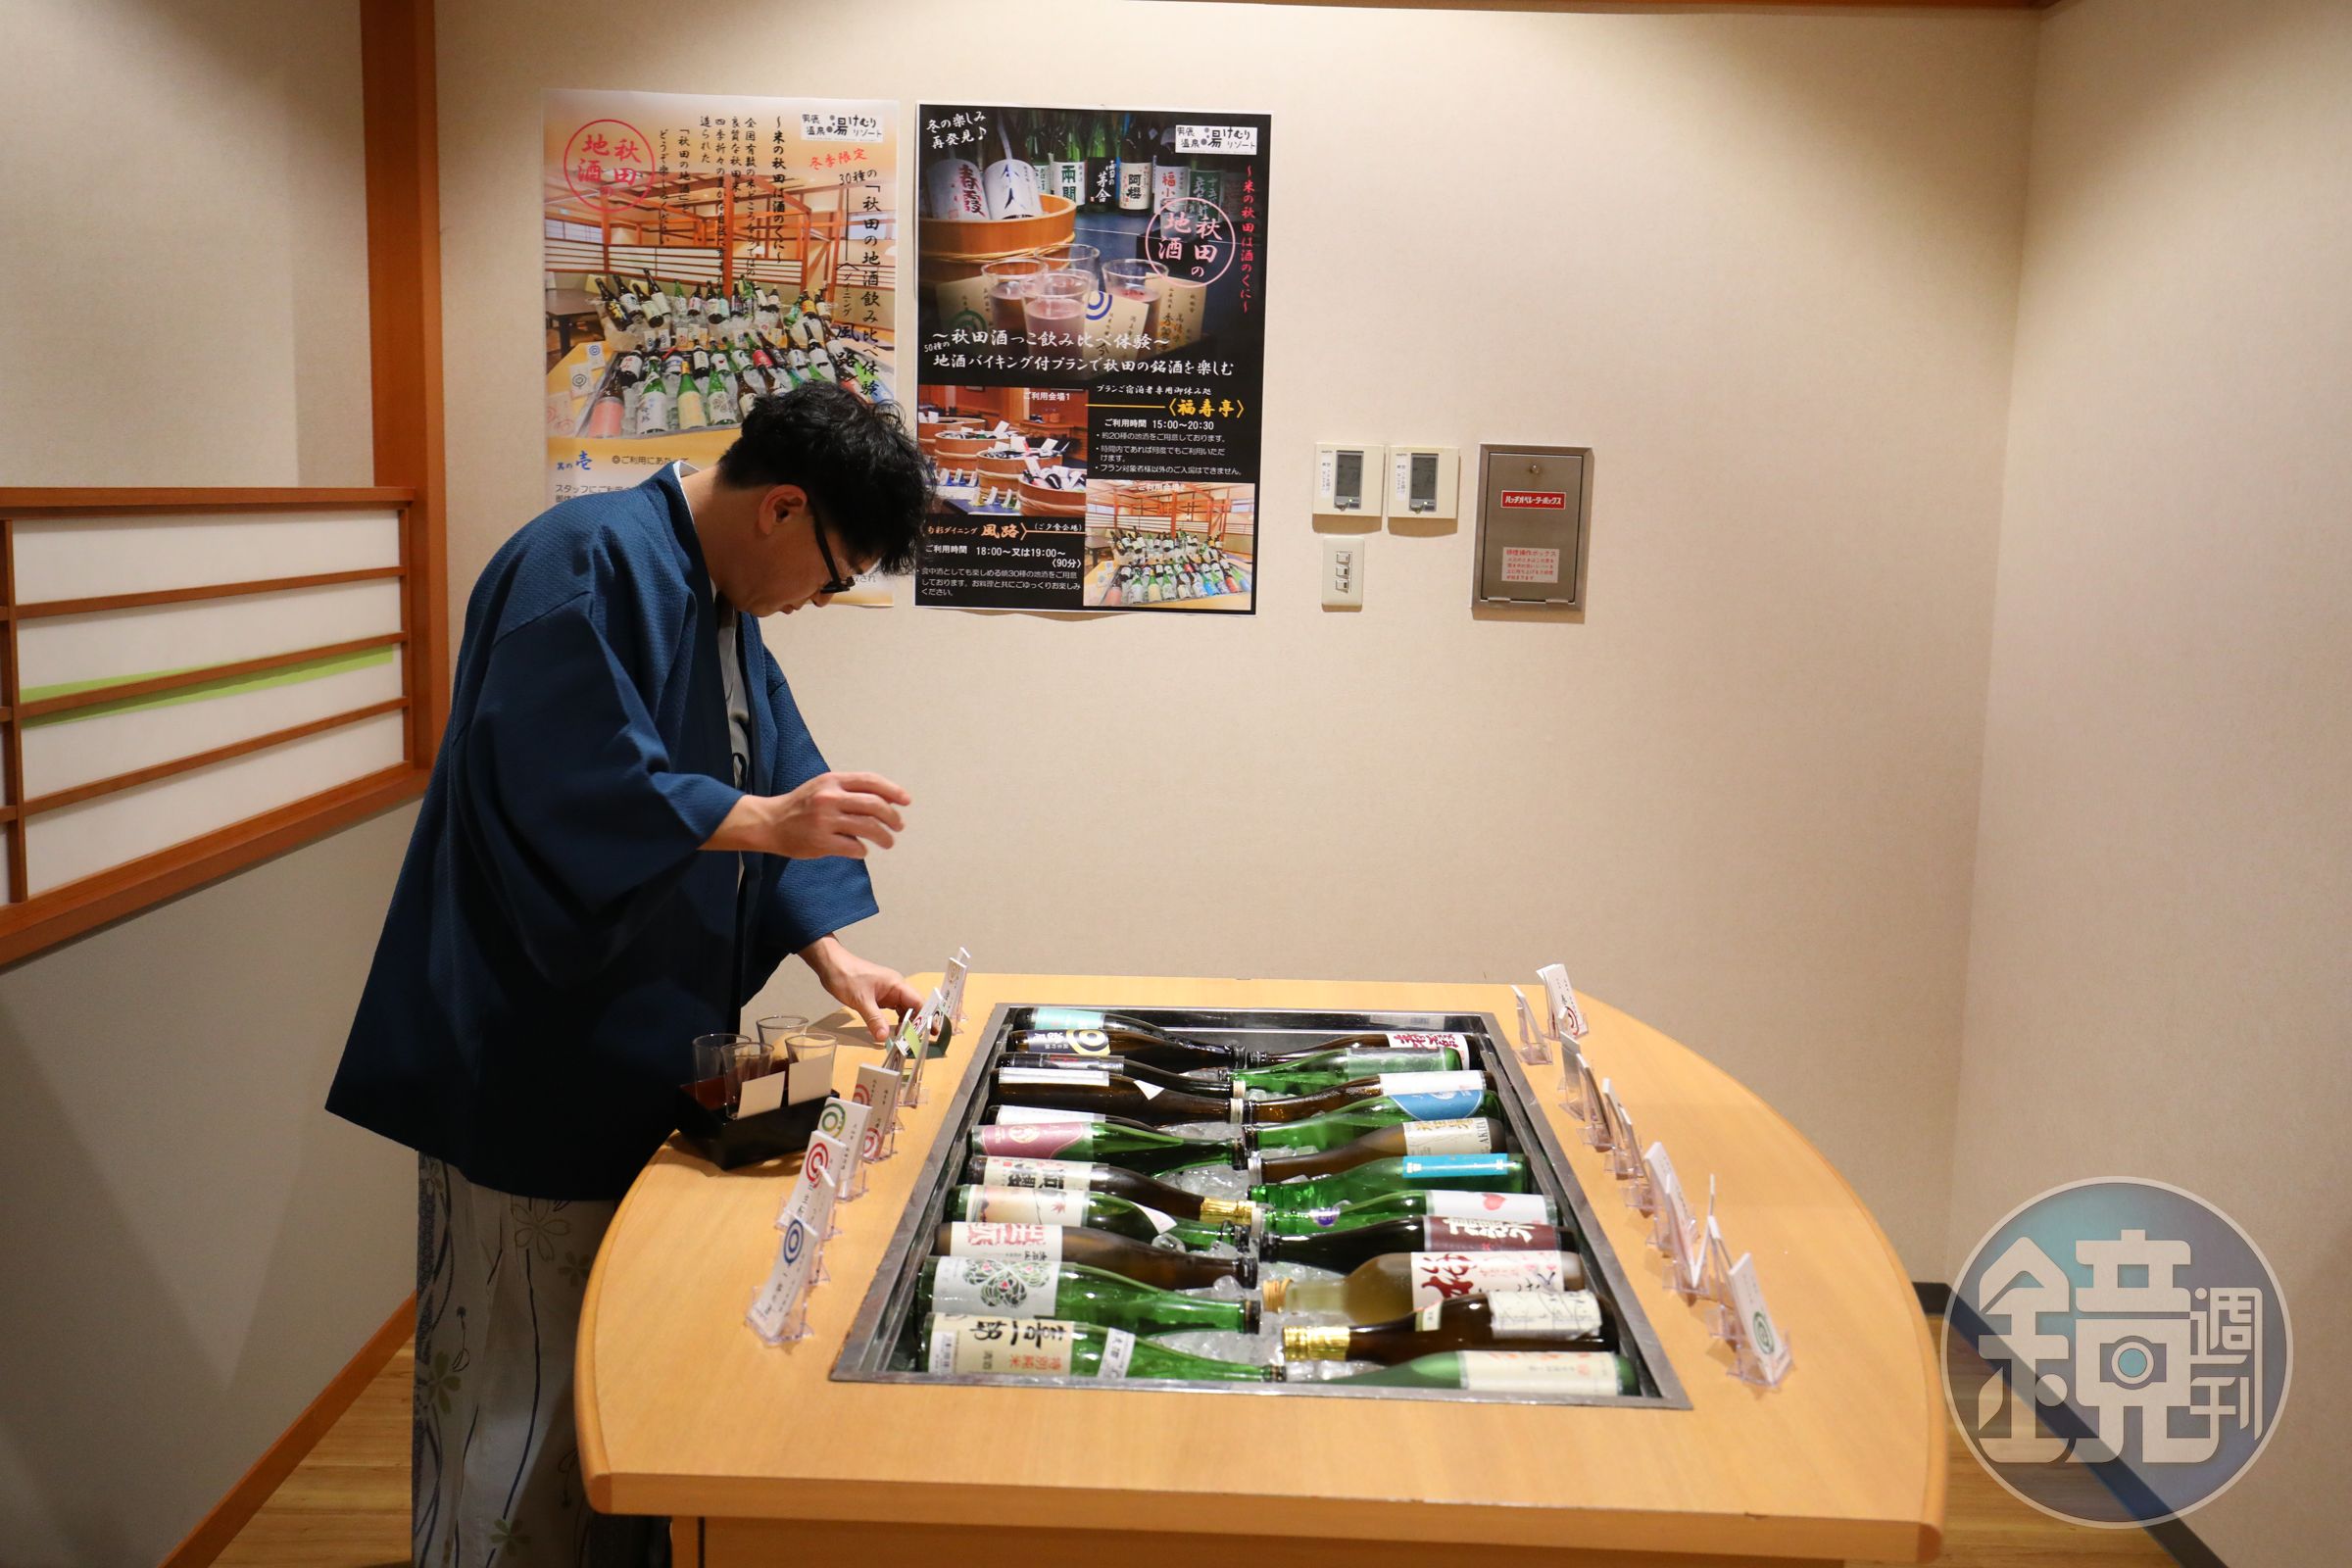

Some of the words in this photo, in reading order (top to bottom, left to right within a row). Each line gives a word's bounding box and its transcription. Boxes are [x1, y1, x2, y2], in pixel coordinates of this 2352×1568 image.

[853, 128, 882, 137] リゾート
[926, 111, 986, 133] 冬の楽しみ
[699, 115, 711, 164] 造られた
[1227, 141, 1255, 150] リゾート
[578, 132, 611, 183] 地酒
[809, 148, 867, 170] 冬季限定
[839, 170, 877, 185] 30種の
[1158, 211, 1193, 261] 地酒
[1191, 218, 1223, 278] 秋田の
[933, 354, 1235, 376] 地酒バイキング付プランで秋田の銘酒を楽しむ
[1104, 418, 1148, 428] ご利用時間
[926, 545, 968, 555] ご利用時間
